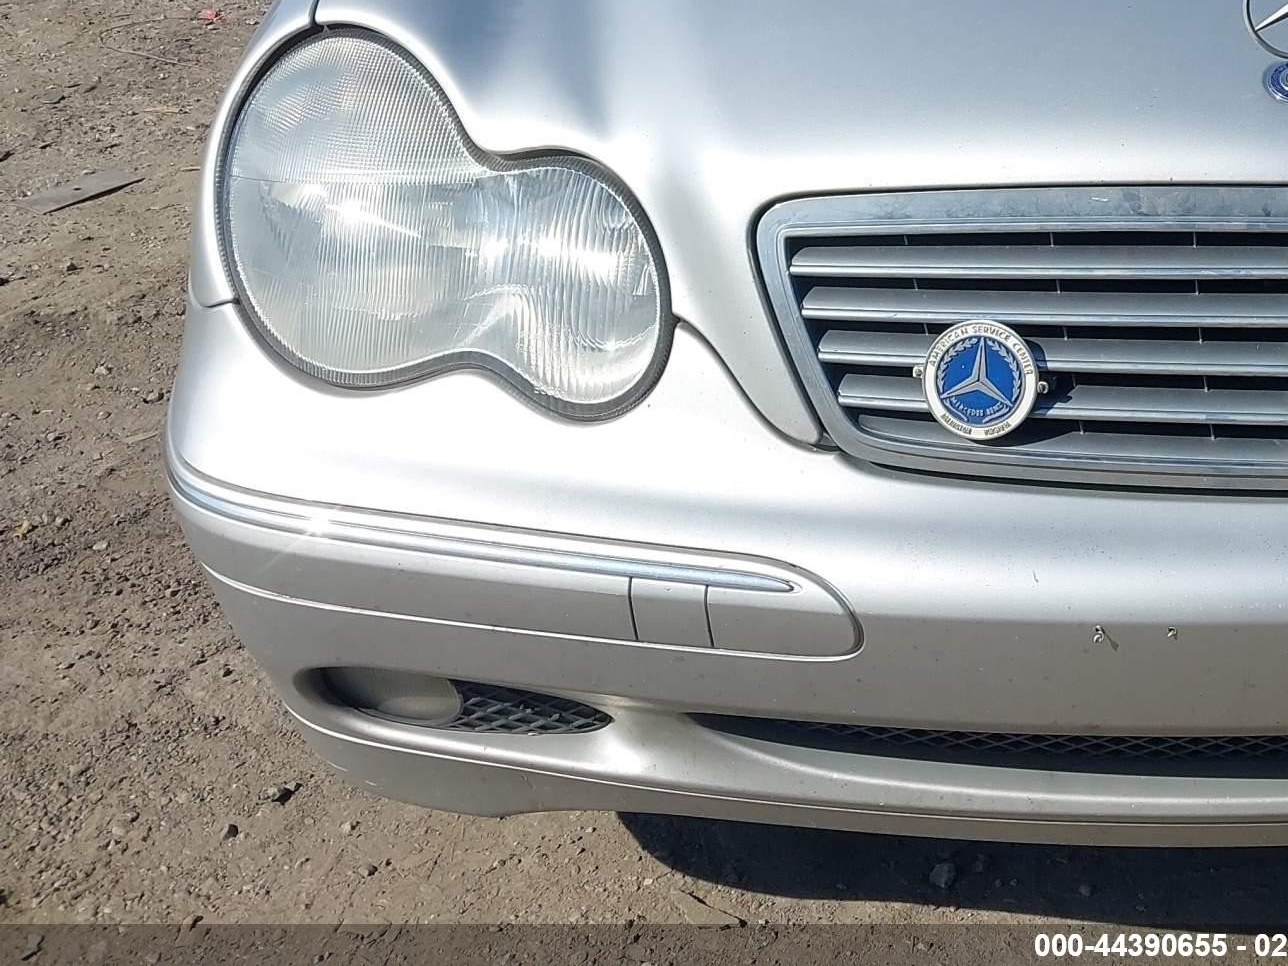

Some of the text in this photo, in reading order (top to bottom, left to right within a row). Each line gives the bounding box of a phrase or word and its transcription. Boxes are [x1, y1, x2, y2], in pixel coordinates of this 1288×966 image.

[928, 325, 1034, 375] AMERICAN SERVICE CENTER
